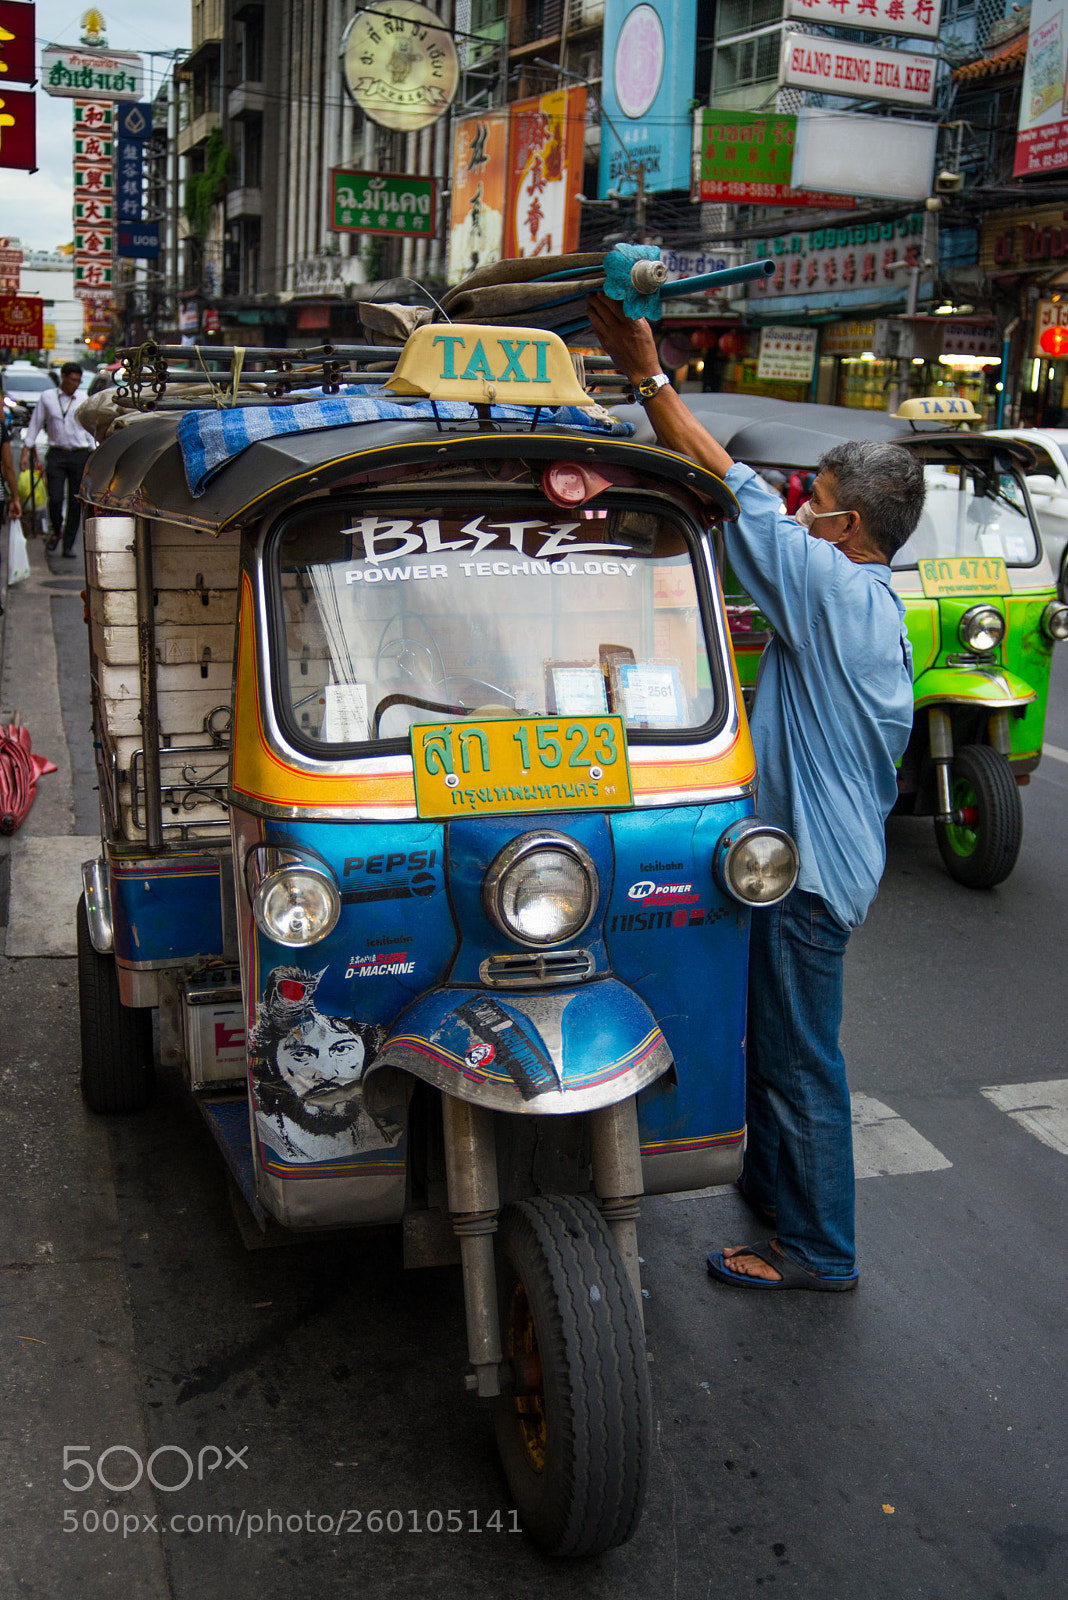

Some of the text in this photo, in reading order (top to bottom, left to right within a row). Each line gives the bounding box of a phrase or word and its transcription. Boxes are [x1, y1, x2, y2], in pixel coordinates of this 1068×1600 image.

[791, 48, 932, 92] SIANG HENG HUA KEE
[83, 106, 104, 284] 和成興大金行
[336, 176, 430, 215] ฉ.มั่นคง
[133, 235, 158, 246] UOB
[433, 335, 552, 383] TAXI
[919, 400, 969, 414] TAXI
[345, 560, 637, 585] POWER TECHNOLOGY
[959, 559, 1001, 579] 4717
[648, 685, 673, 698] 2561
[512, 722, 619, 769] 1523
[452, 781, 600, 810] กรุงเทพมหานคร
[343, 849, 437, 877] PEPSI
[643, 893, 701, 905] EVOLUTION
[654, 884, 692, 896] POWER
[377, 952, 409, 965] SUPE
[344, 961, 416, 979] D-MACHINE
